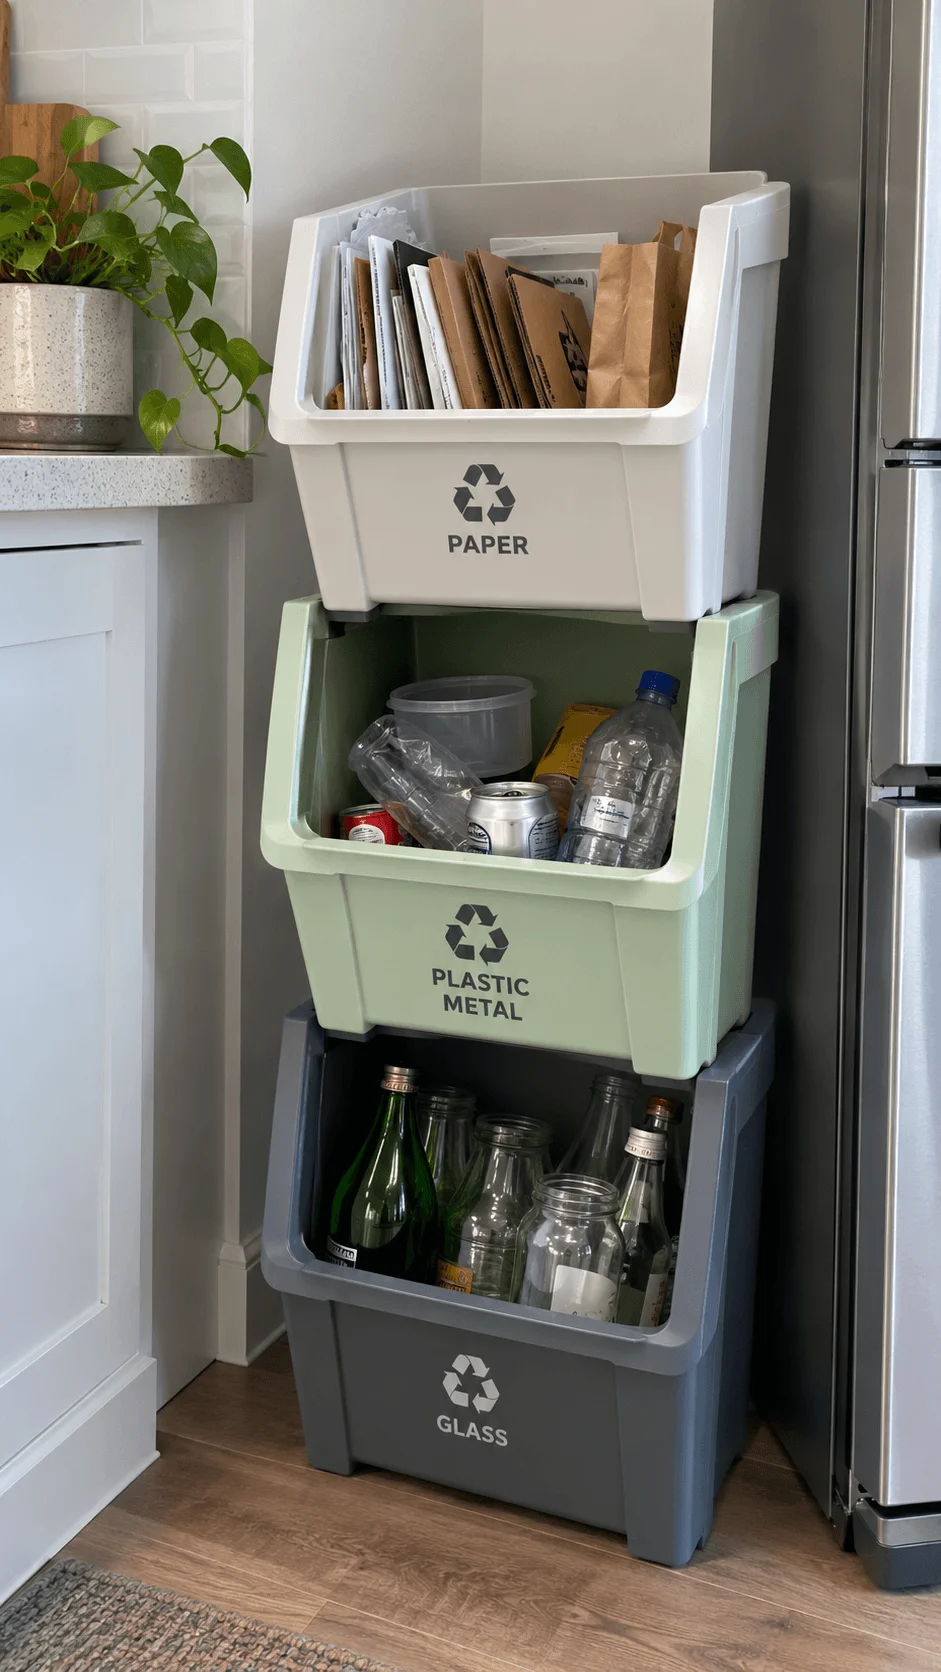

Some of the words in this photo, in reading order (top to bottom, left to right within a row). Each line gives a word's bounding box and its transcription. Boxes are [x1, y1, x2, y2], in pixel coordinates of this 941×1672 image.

[447, 534, 529, 555] PAPER
[431, 967, 530, 997] PLASTIC
[443, 993, 523, 1022] METAL
[436, 1415, 509, 1448] GLASS
